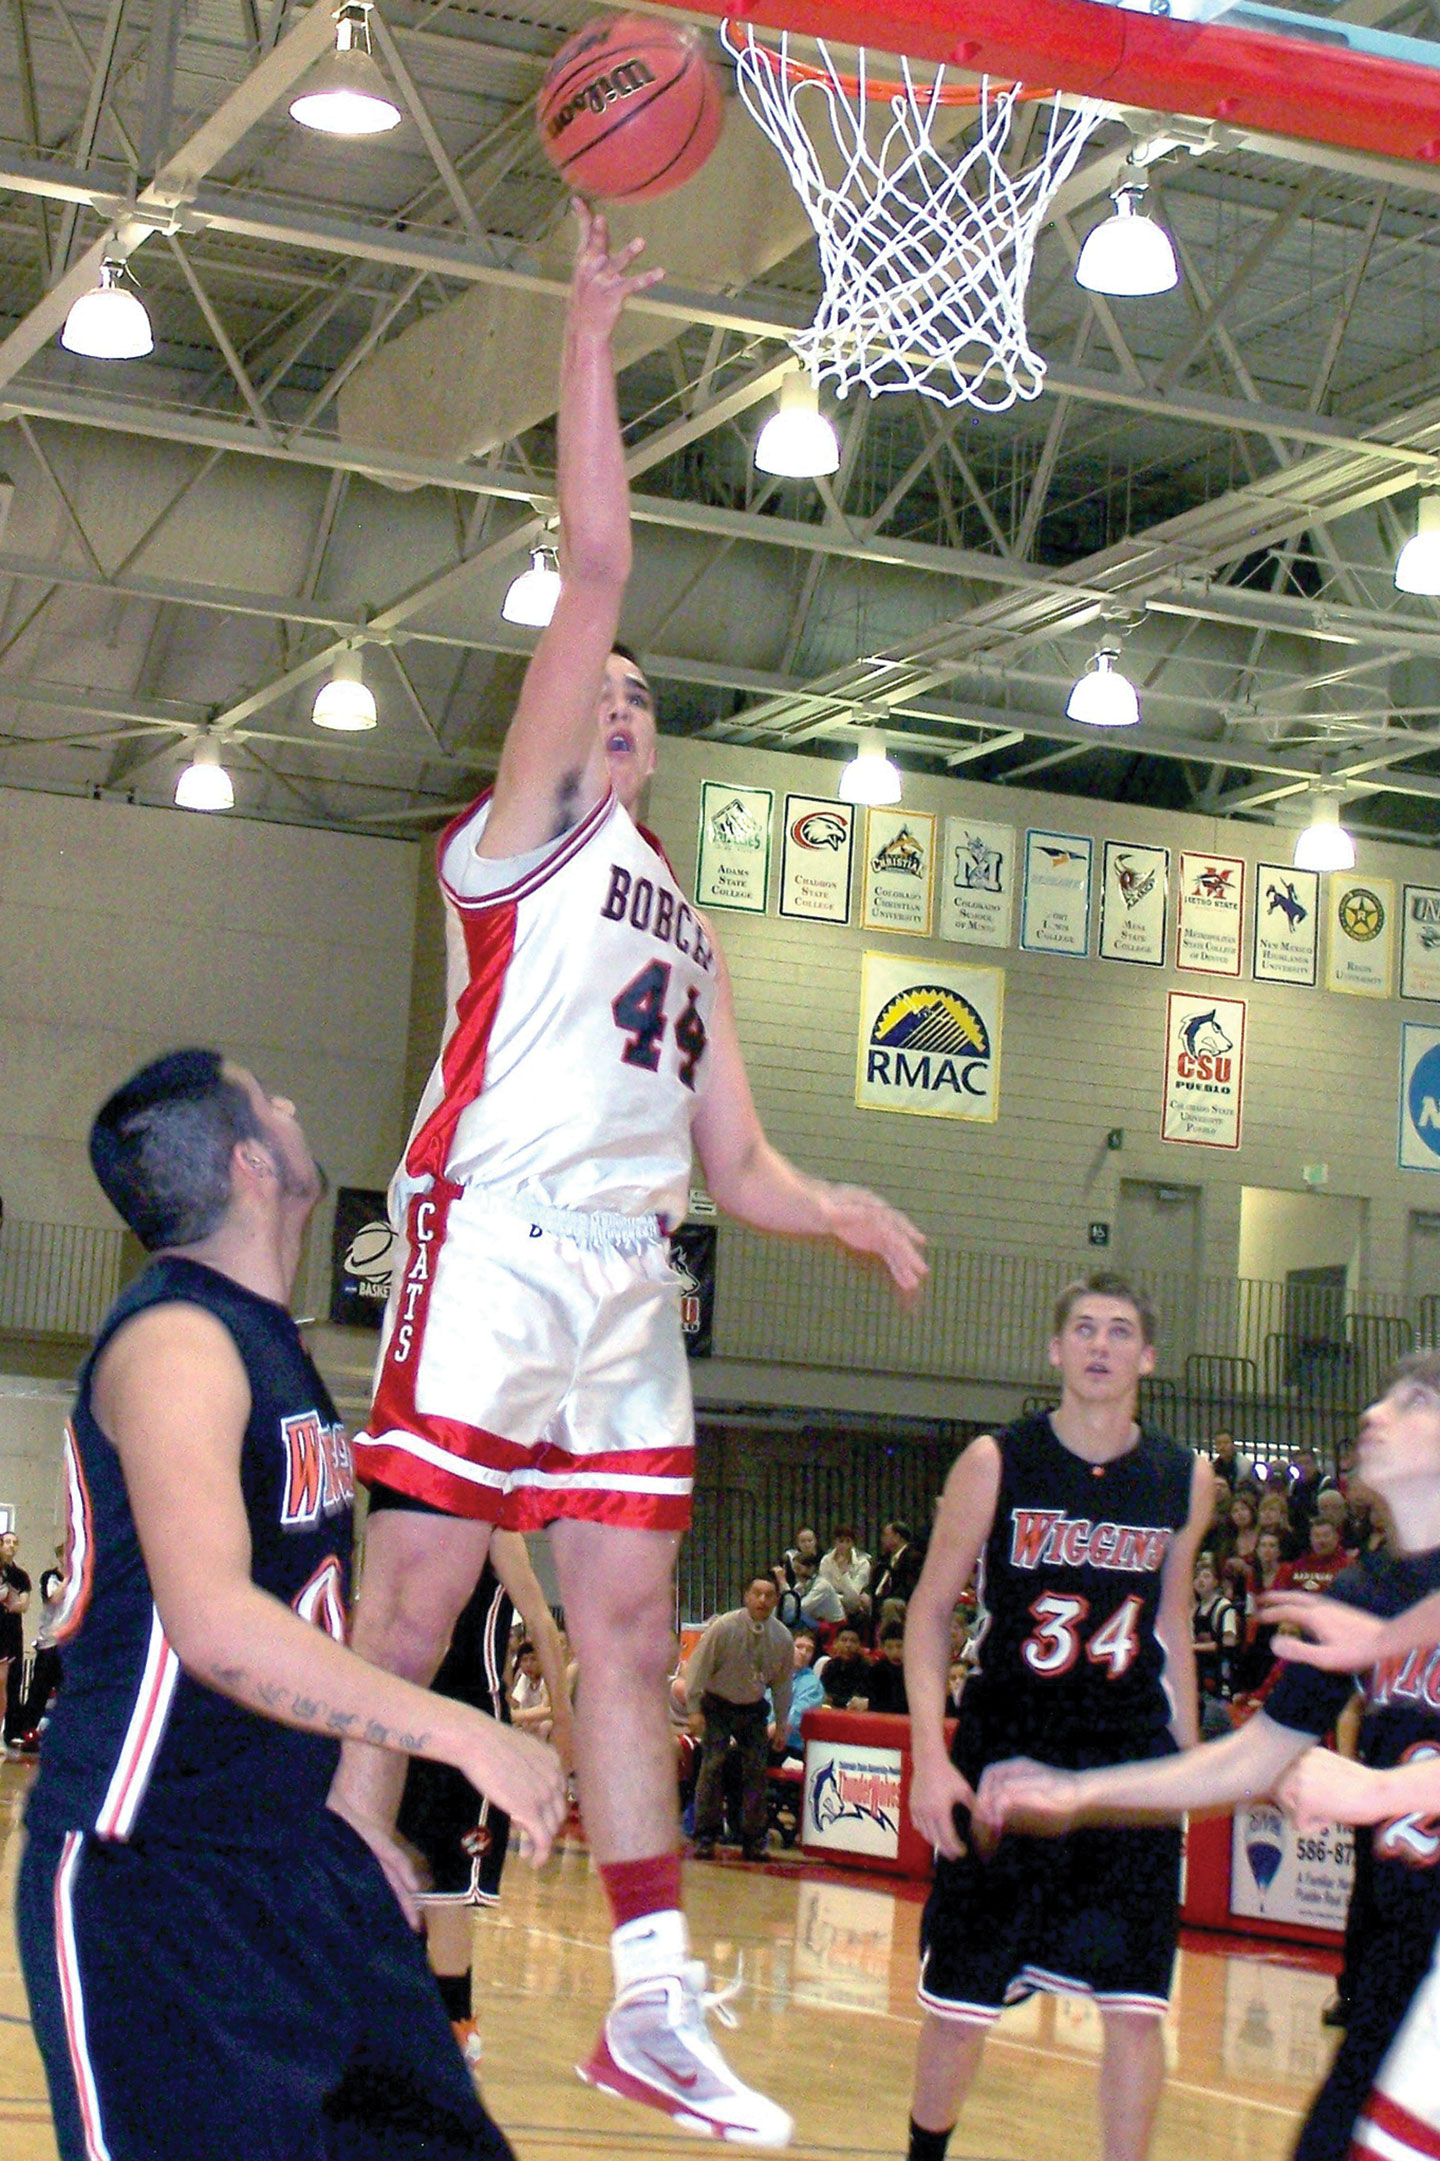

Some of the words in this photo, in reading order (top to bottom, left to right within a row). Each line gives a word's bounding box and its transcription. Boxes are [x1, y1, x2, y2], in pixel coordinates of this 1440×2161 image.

[717, 864, 749, 877] ADAMS
[718, 876, 747, 888] STATE
[711, 885, 752, 899] COLLEGE
[801, 887, 828, 899] STATE
[874, 886, 922, 900] COLORADO
[794, 897, 834, 911] COLLEGE
[873, 897, 920, 911] CHRISTIAN
[954, 897, 1001, 912] COLORADO
[1214, 900, 1238, 911] STATE
[871, 908, 922, 923] UNIVERSITY
[1045, 911, 1068, 922] ORT
[1120, 929, 1147, 942] STATE
[1281, 941, 1313, 954] MEXICO
[1262, 960, 1308, 974] UNIVERSITY
[610, 957, 707, 1092] 44
[867, 1049, 989, 1096] RMAC
[1177, 1052, 1232, 1083] CSU
[1175, 1080, 1231, 1095] PUEBLO
[394, 1202, 436, 1362] CATS
[1020, 1588, 1145, 1680] 34
